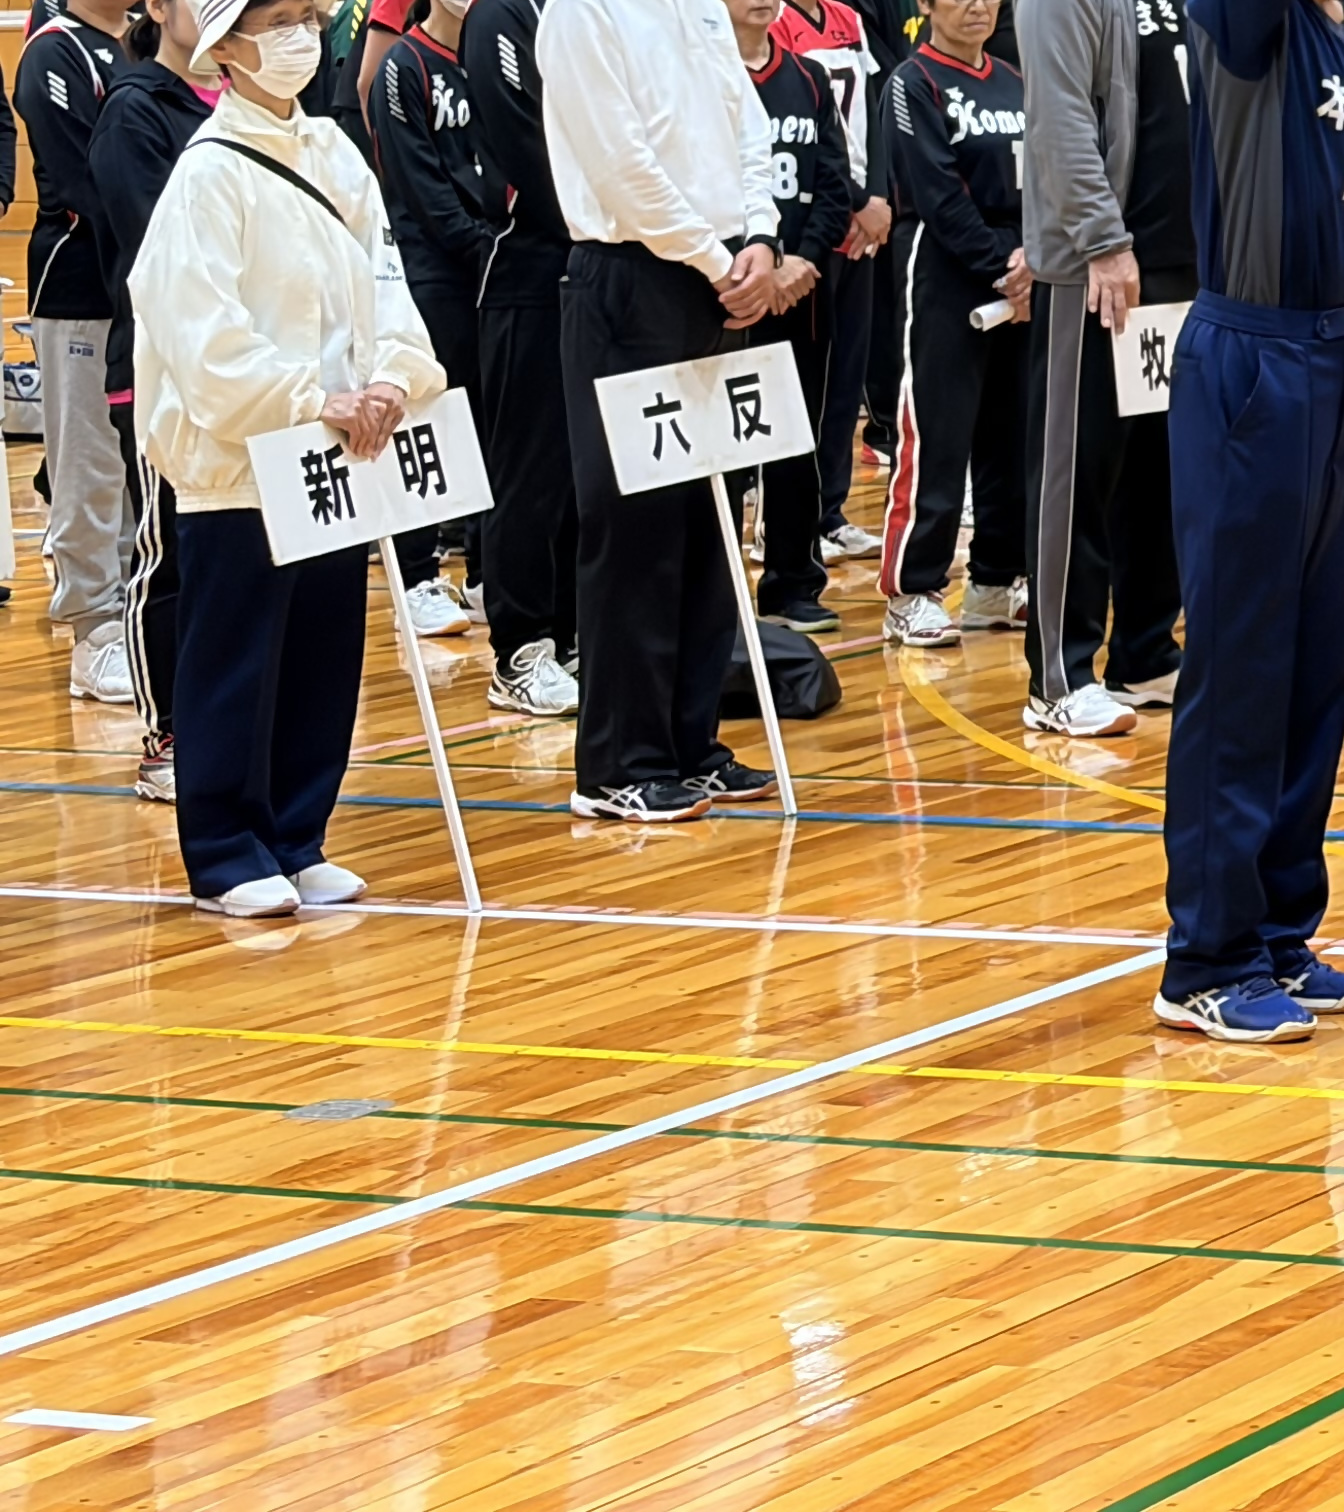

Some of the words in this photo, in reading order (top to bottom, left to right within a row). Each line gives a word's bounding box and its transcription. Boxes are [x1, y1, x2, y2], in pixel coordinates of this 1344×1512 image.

[1139, 326, 1170, 392] 牧
[641, 372, 772, 462] 六反
[299, 422, 448, 526] 新明
